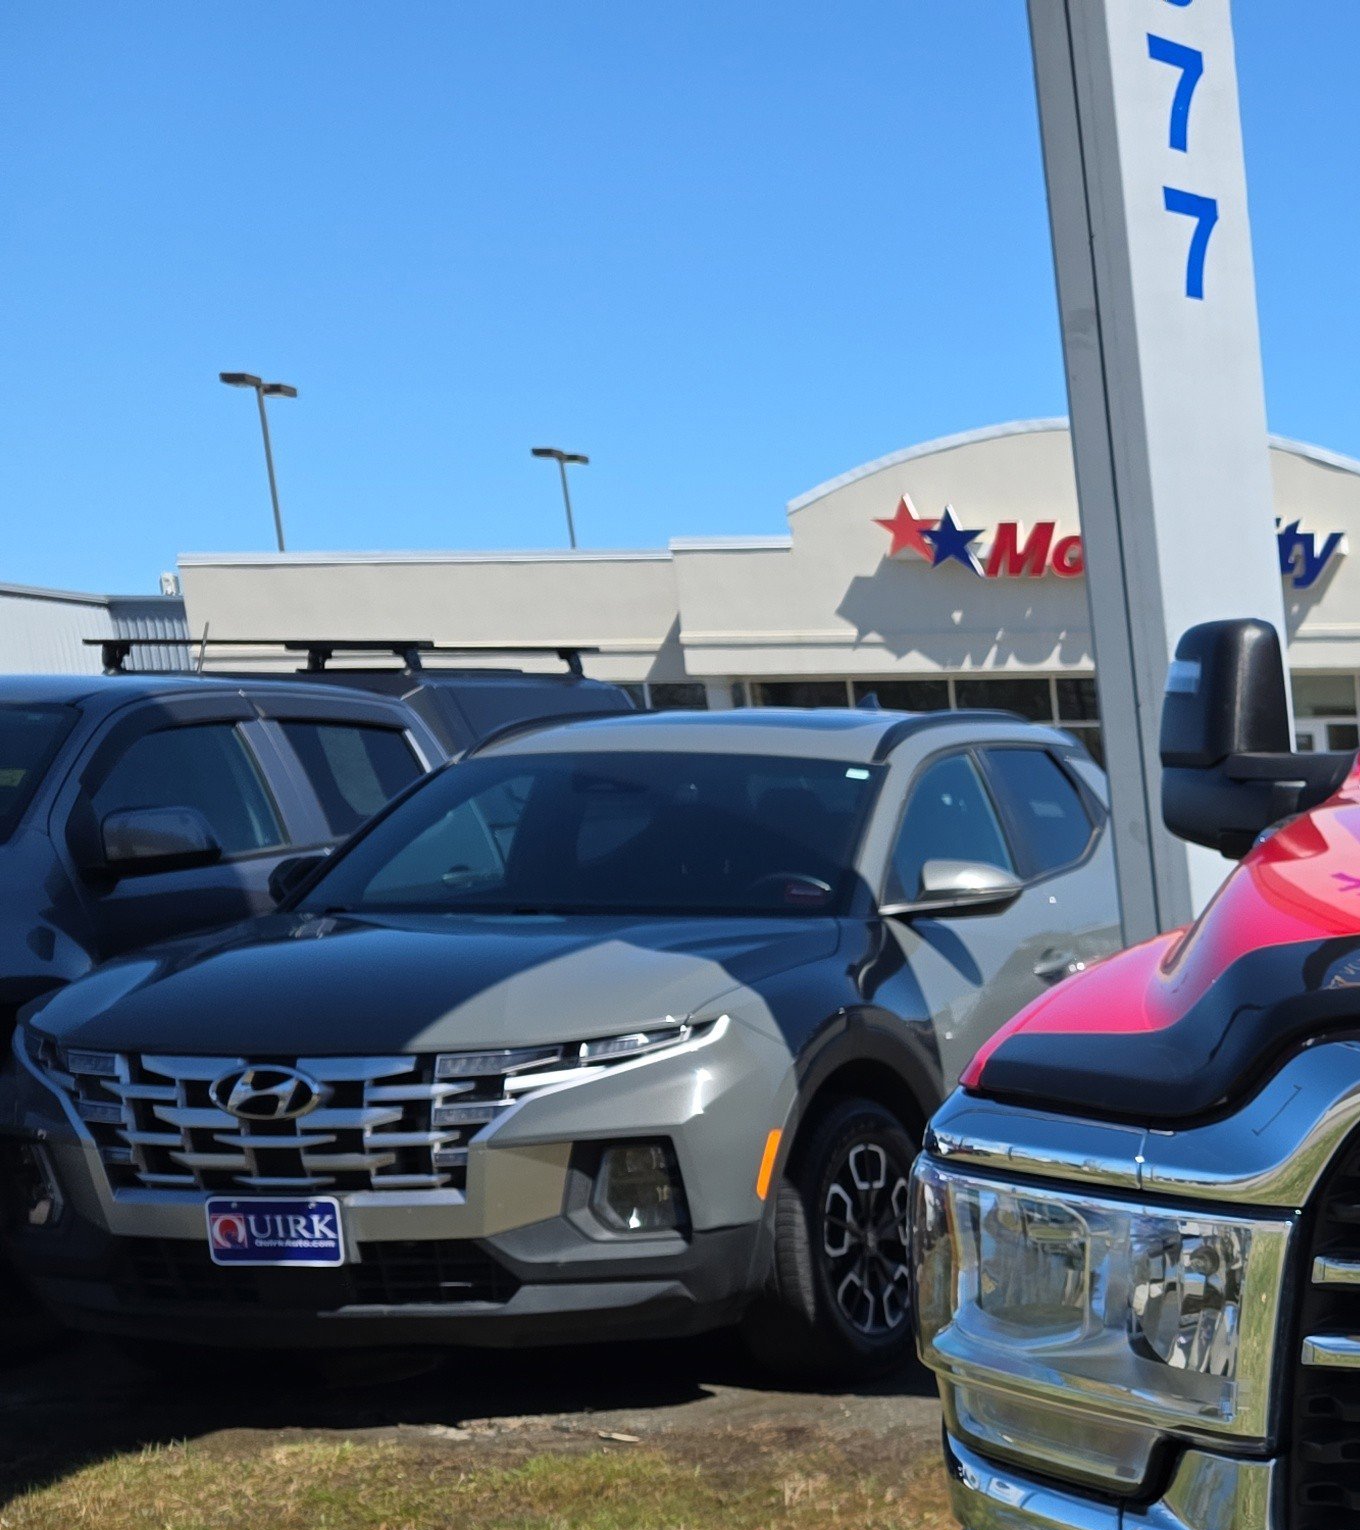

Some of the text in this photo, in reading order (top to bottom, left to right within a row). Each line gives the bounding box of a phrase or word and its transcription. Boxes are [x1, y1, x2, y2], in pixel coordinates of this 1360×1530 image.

[1146, 0, 1219, 300] 77
[1275, 517, 1345, 590] ty
[212, 1213, 338, 1249] QUIRK
